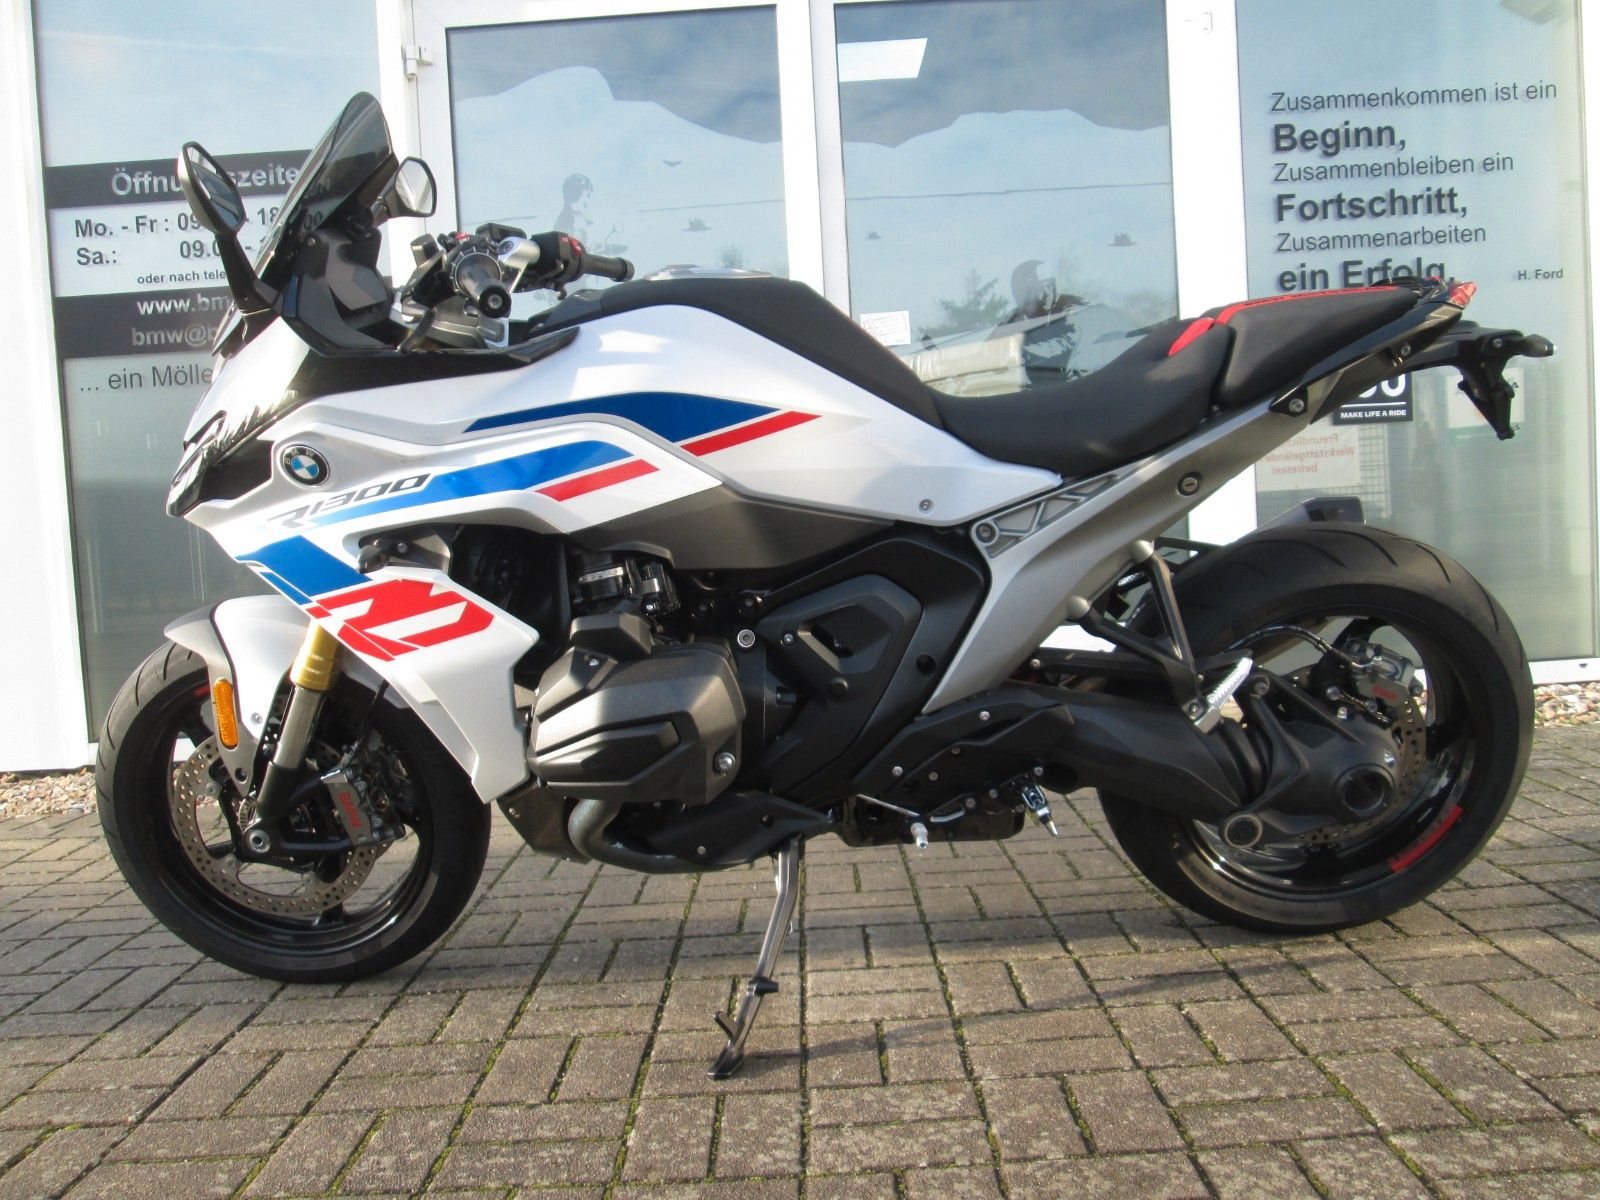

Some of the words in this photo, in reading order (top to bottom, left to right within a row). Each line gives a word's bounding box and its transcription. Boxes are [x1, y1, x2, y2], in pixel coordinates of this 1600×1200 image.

[1271, 85, 1487, 112] Zusammenkommen
[1494, 82, 1519, 101] ist
[1525, 80, 1558, 99] ein
[1273, 121, 1406, 156] Beginn,
[1273, 155, 1475, 182] Zusammenbleiben
[1482, 153, 1514, 171] ein
[1277, 186, 1467, 221] Fortschritt,
[75, 218, 114, 238] Mo.
[1276, 225, 1487, 253] Zusammenarbeiten
[179, 239, 221, 259] 09.0
[137, 273, 165, 285] oder
[169, 271, 200, 282] nach
[204, 269, 228, 280] tele
[1278, 262, 1330, 292] ein
[1517, 270, 1531, 281] H.
[1534, 267, 1564, 280] Ford
[136, 292, 231, 315] www.bm
[108, 367, 143, 390] ein
[151, 363, 213, 388] Mölle
[1340, 411, 1363, 419] MAKE
[1364, 410, 1382, 418] LIFE
